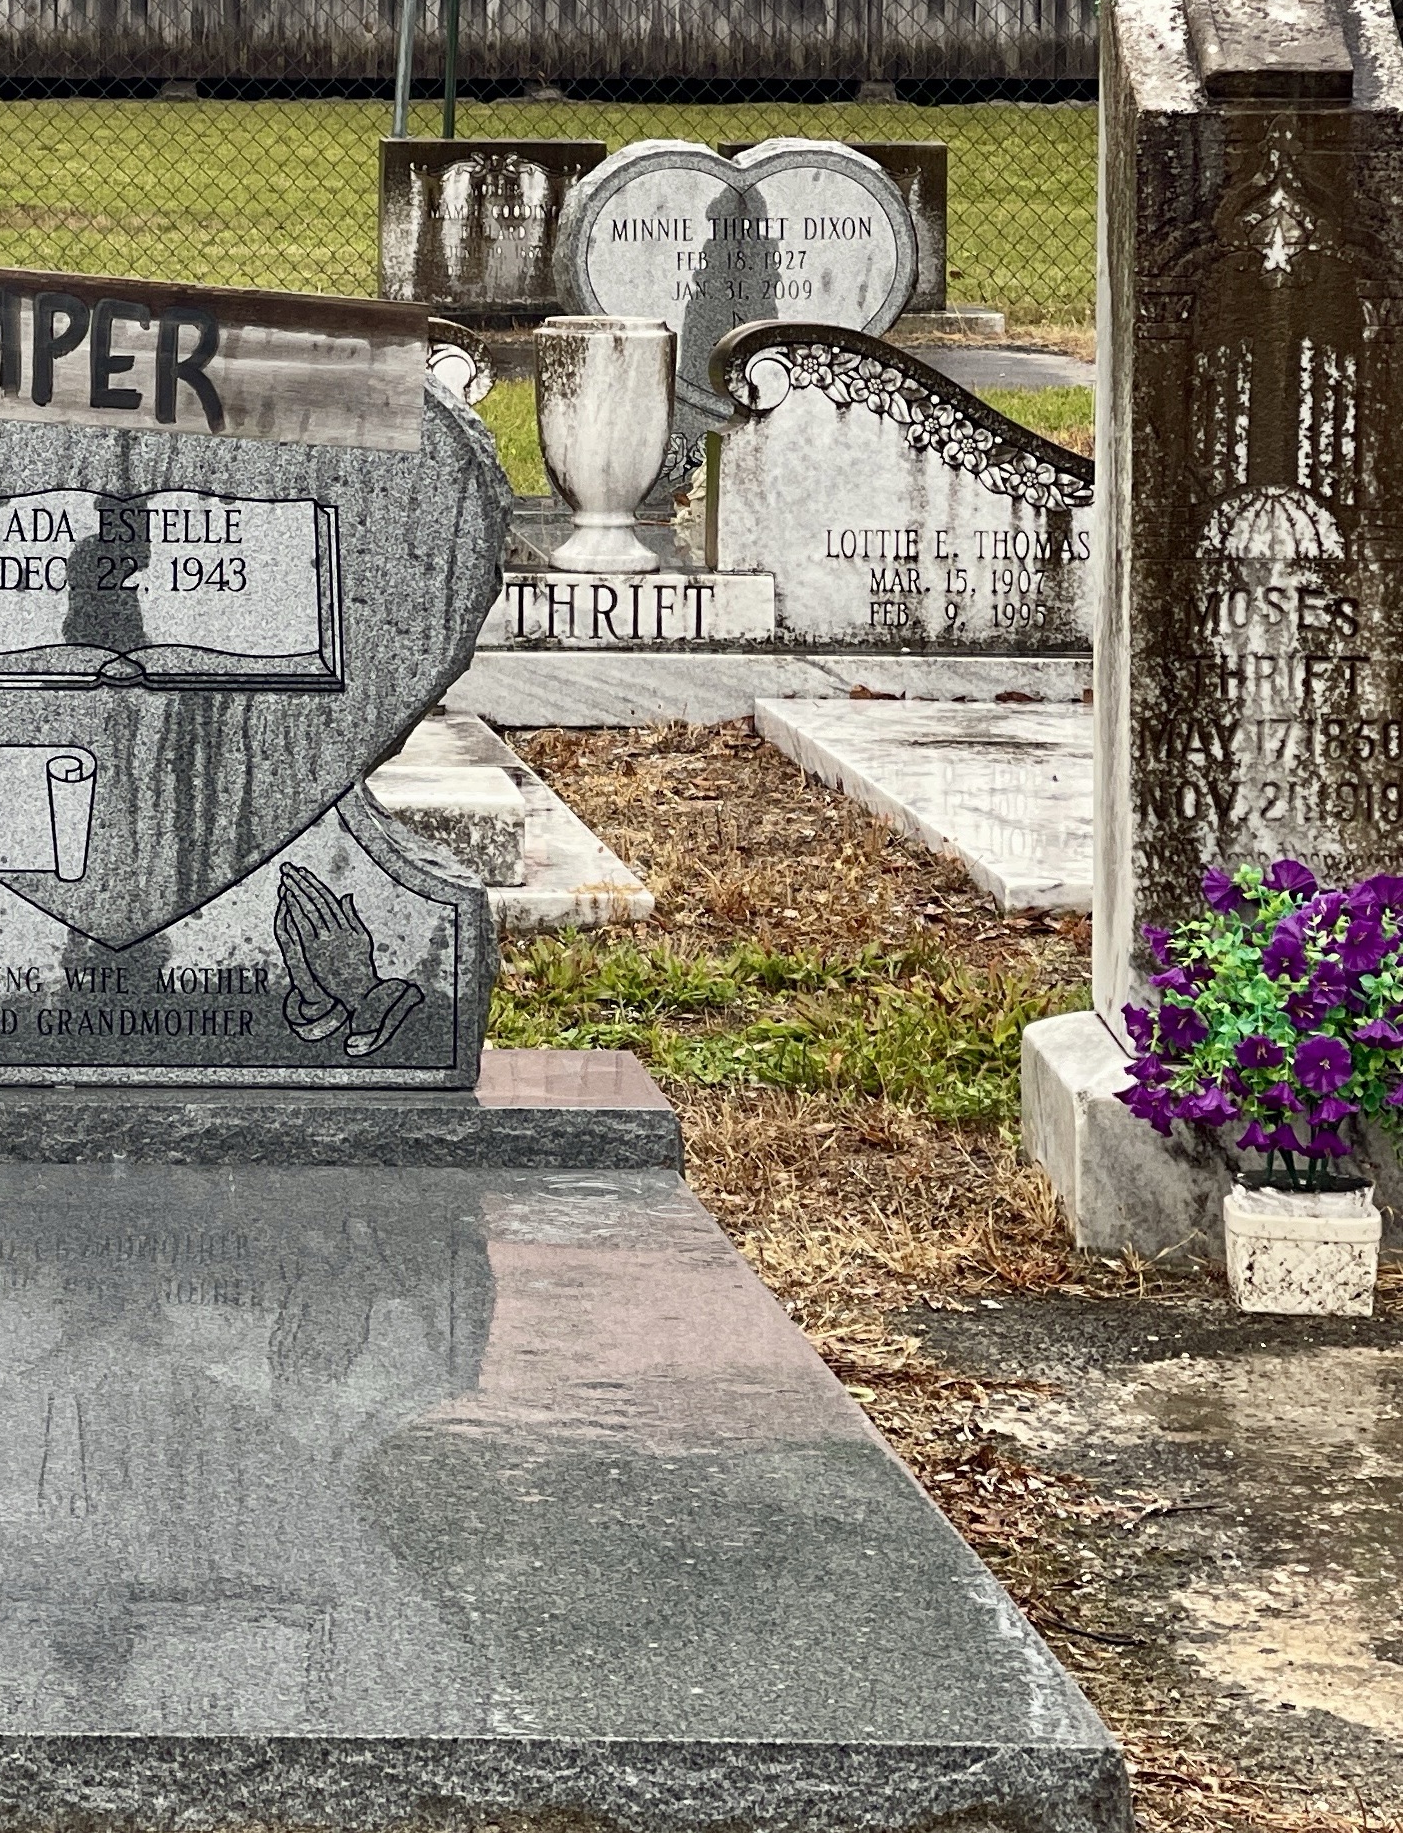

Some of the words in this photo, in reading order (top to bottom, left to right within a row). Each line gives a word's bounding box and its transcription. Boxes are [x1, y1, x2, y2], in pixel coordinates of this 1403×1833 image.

[611, 217, 694, 242] MINNIE
[709, 217, 789, 242] THRIFT
[803, 217, 873, 241] DIXON
[764, 250, 807, 270] 1927
[762, 279, 812, 300] 2009
[2, 508, 76, 544] ADA
[96, 508, 243, 545] ESTELLE
[826, 528, 919, 562] LOTTIE
[935, 529, 959, 559] E.
[974, 530, 1091, 562] THOMAS
[97, 556, 149, 595] 22,
[170, 556, 248, 593] 1943
[869, 567, 931, 594] MAR.
[945, 569, 977, 597] 15,
[990, 569, 1047, 595] 1907
[505, 582, 715, 641] THRIFT
[992, 602, 1048, 628] 1995
[1183, 585, 1360, 644] MOSES
[1182, 653, 1372, 701] THRIFT
[1140, 715, 1240, 765] MAY
[155, 966, 271, 995] MOTHER
[37, 1008, 254, 1037] GRANDMOTHER
